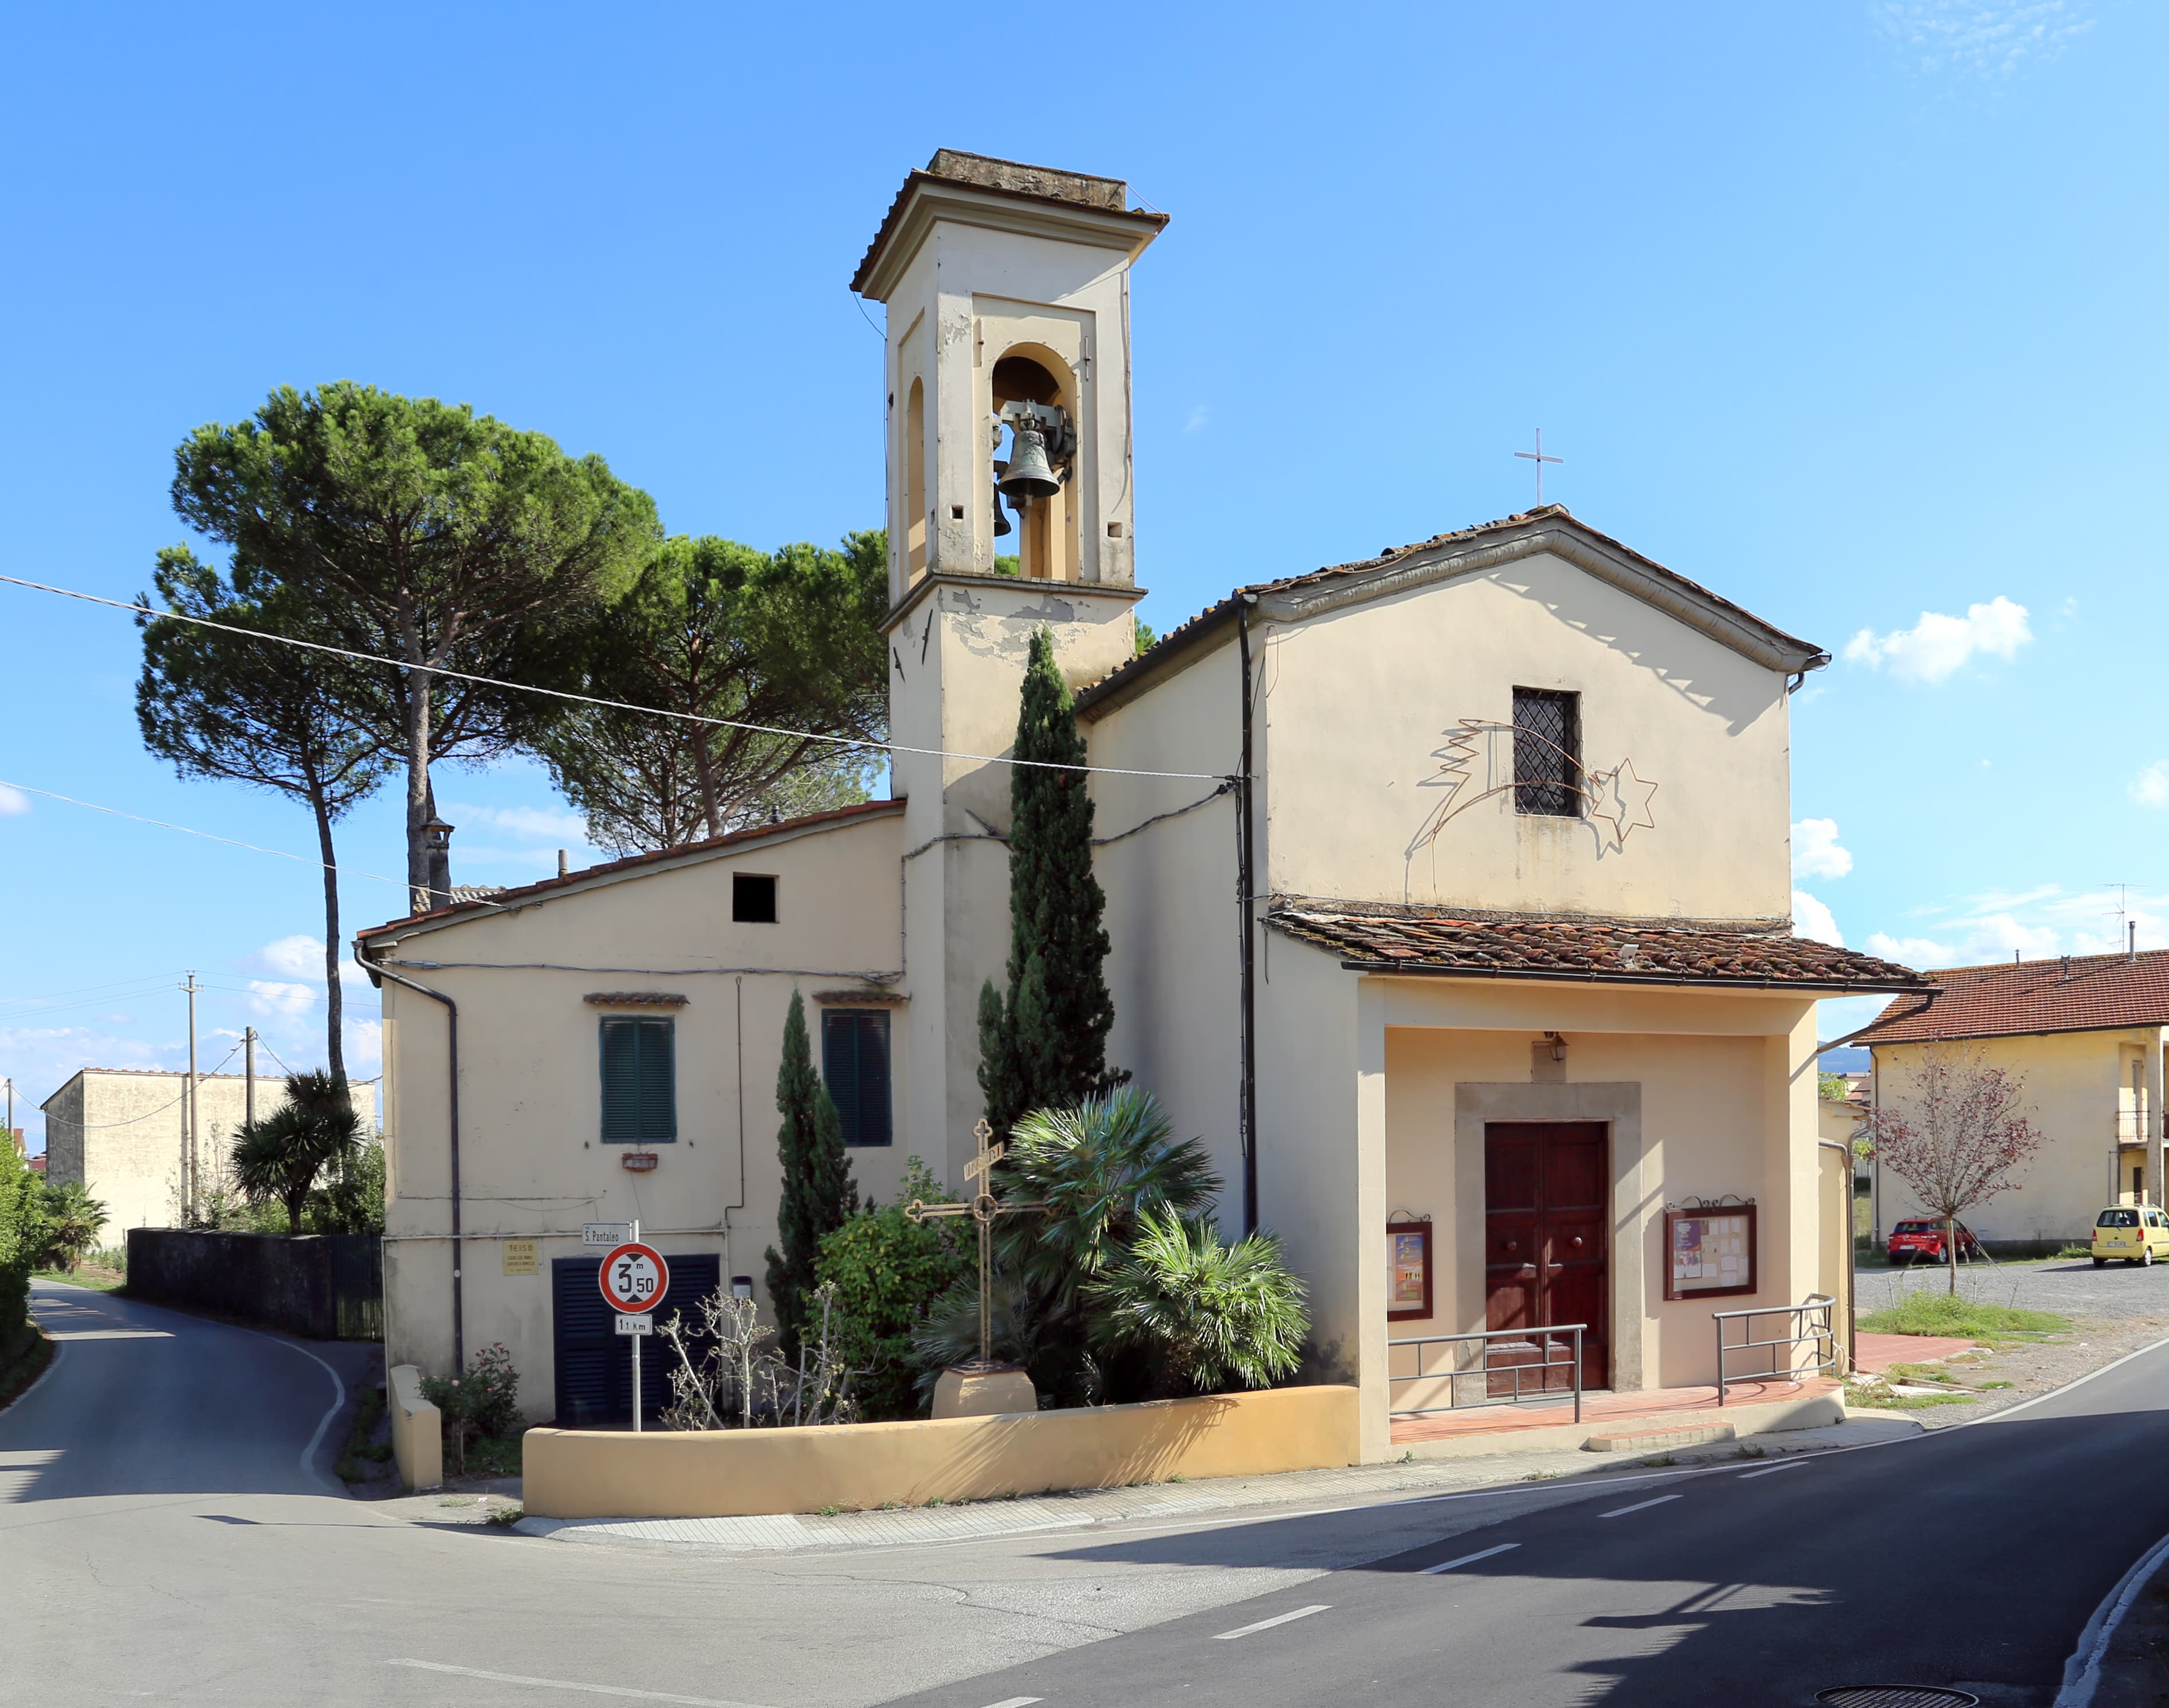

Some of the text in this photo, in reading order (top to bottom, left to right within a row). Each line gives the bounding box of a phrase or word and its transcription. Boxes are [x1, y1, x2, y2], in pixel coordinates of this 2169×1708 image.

[586, 1230, 619, 1242] S. Pantaleo
[618, 1264, 632, 1293] 3
[636, 1278, 654, 1293] 50
[633, 1322, 645, 1330] km
